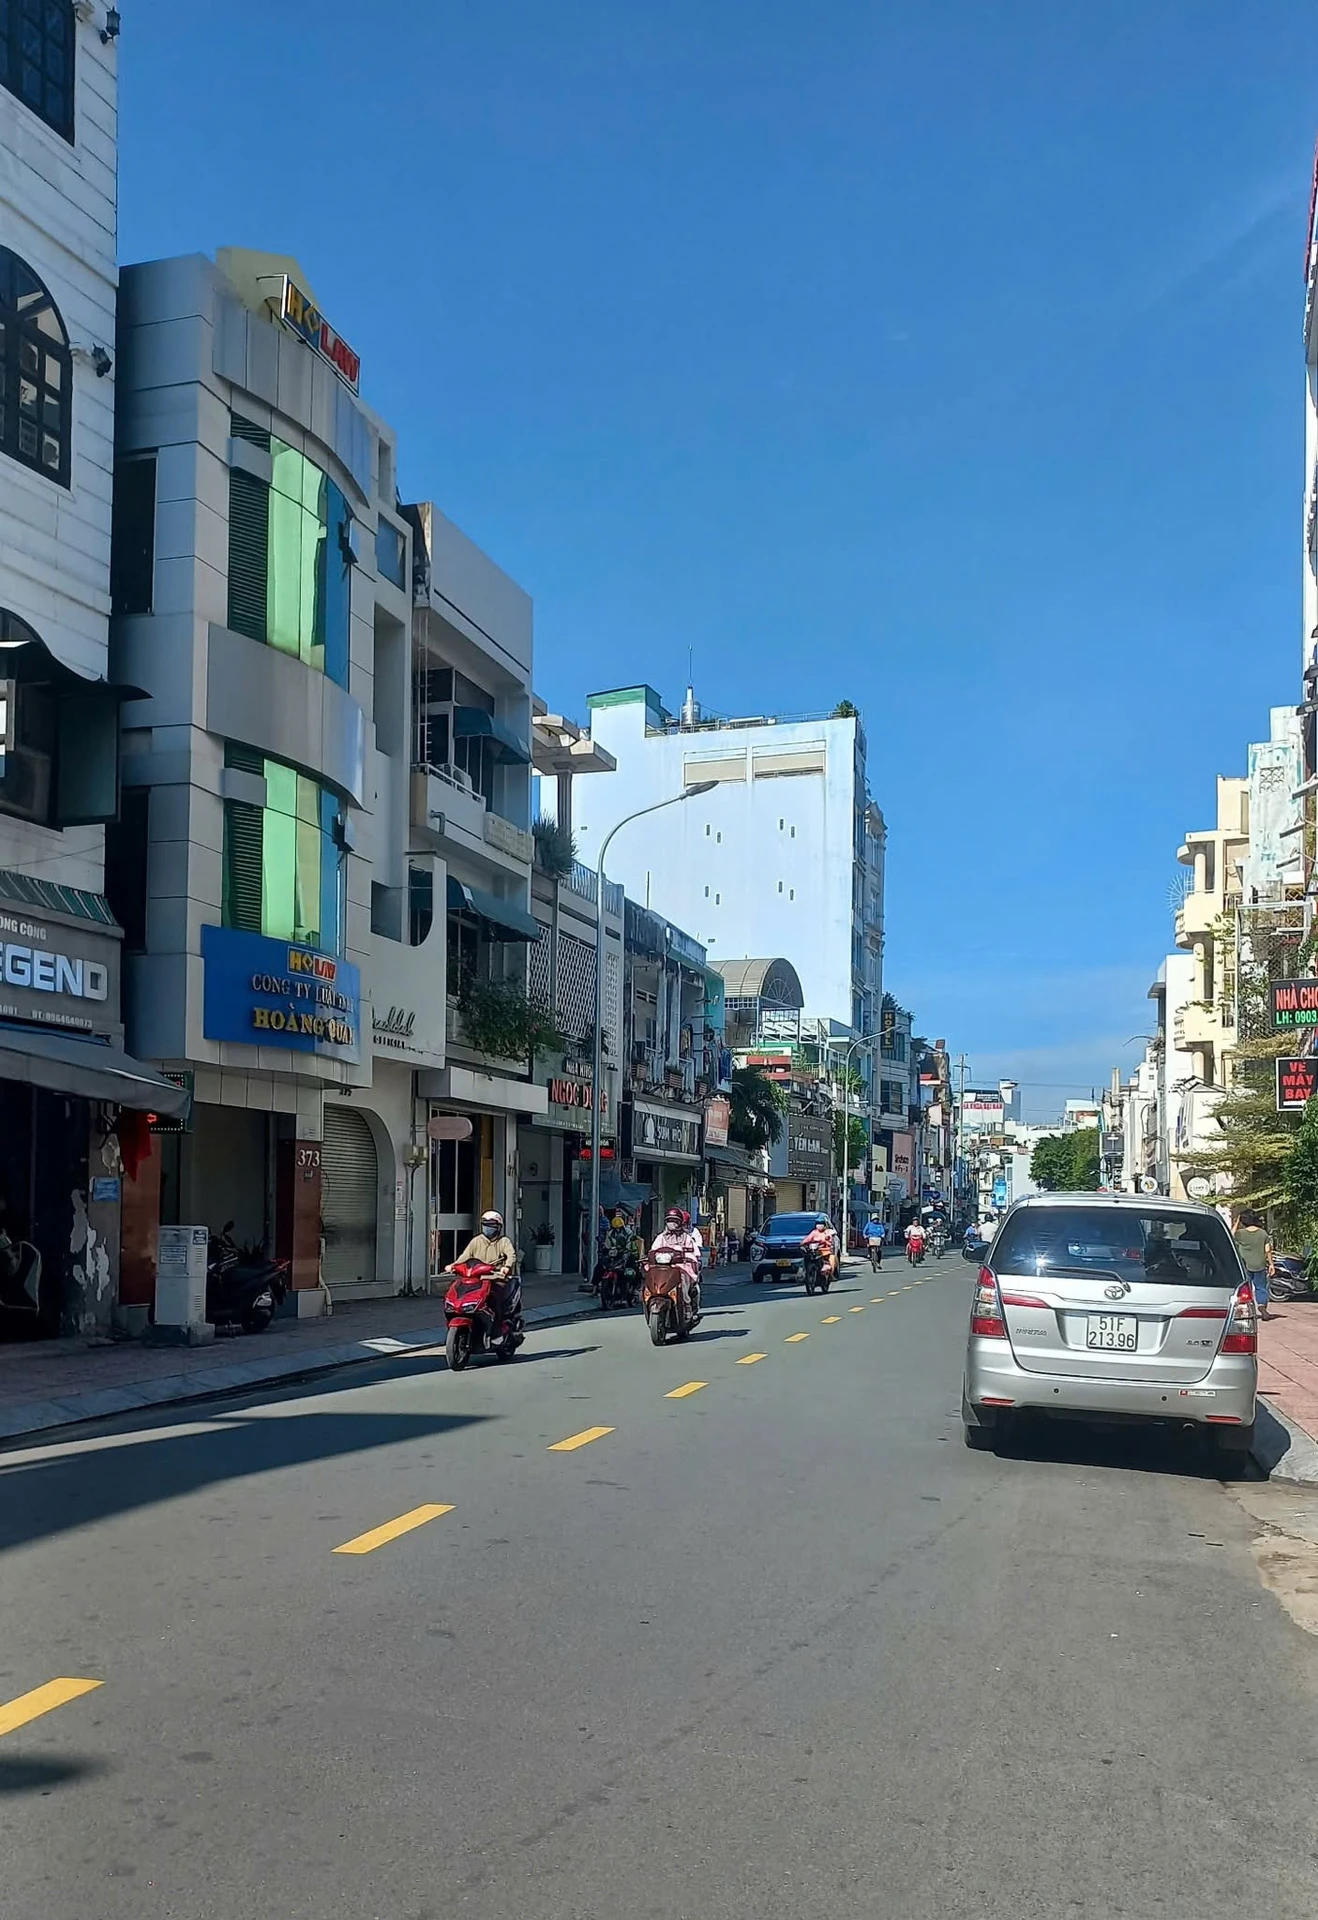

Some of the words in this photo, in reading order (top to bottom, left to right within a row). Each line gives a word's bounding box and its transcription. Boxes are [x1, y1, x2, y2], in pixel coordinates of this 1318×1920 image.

[0, 941, 108, 1001] GEND
[295, 981, 311, 999] TY
[1276, 982, 1298, 1010] NHÀ
[253, 1002, 325, 1036] HOÀNG
[1276, 1011, 1292, 1025] LH:
[1282, 1073, 1314, 1086] MÁY
[1285, 1088, 1312, 1100] BAY
[297, 1149, 320, 1168] 373
[1099, 1316, 1125, 1331] 51F
[1089, 1331, 1134, 1348] 213.96
